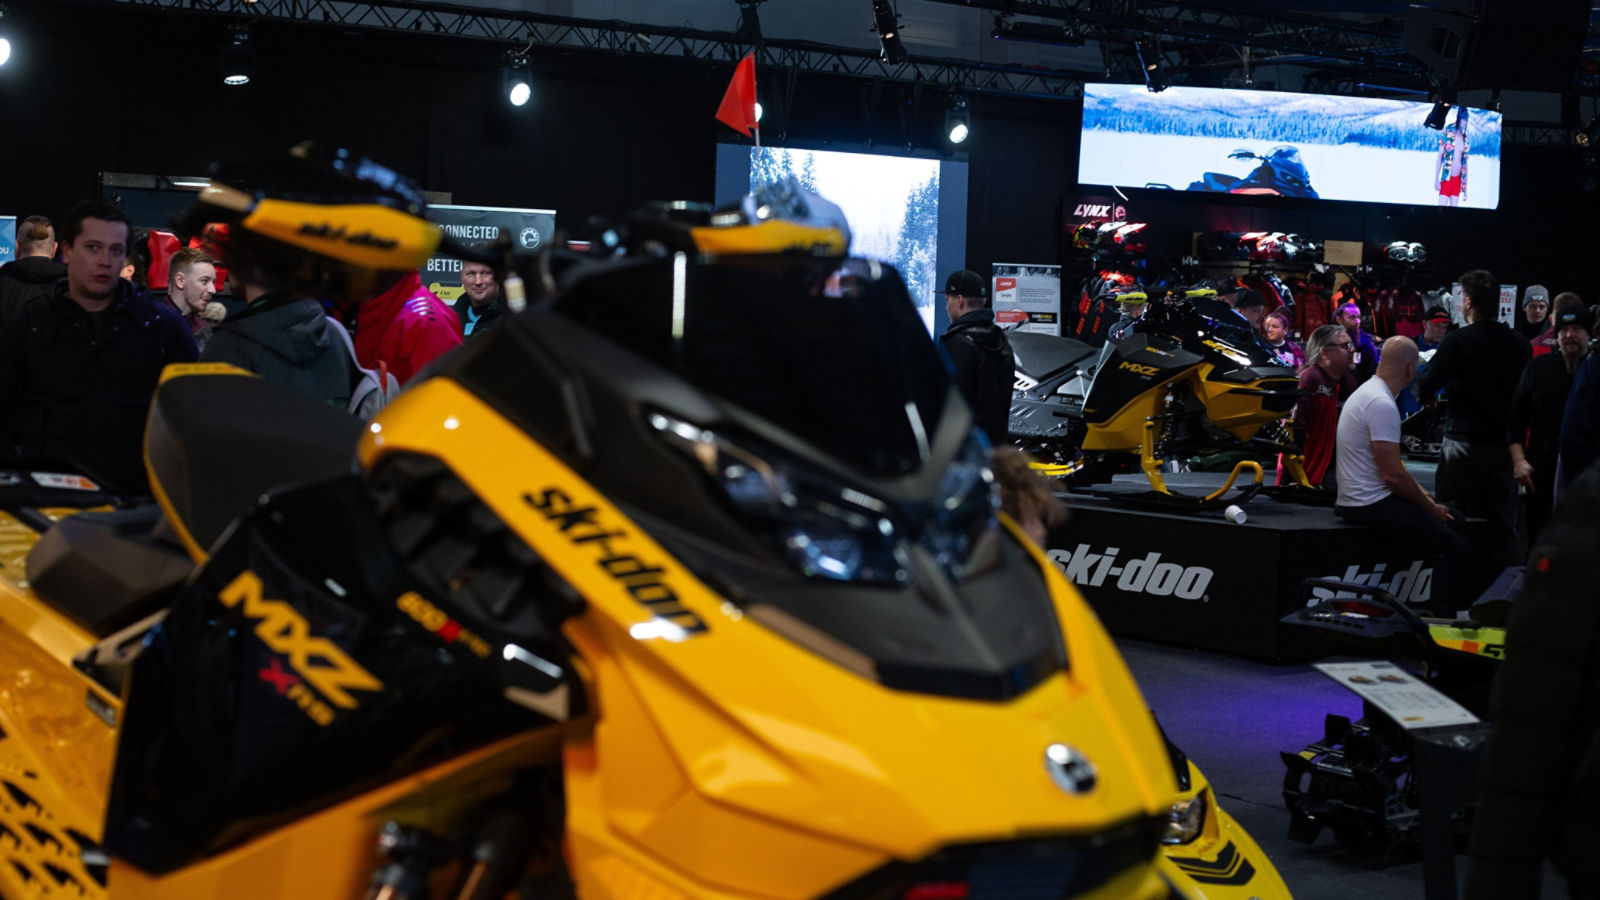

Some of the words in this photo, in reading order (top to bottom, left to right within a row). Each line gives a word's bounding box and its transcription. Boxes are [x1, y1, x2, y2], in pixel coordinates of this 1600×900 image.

[1073, 204, 1111, 218] LYNX
[1118, 361, 1160, 376] MXZ
[1046, 543, 1214, 601] ski-doo
[218, 569, 385, 710] MXZ
